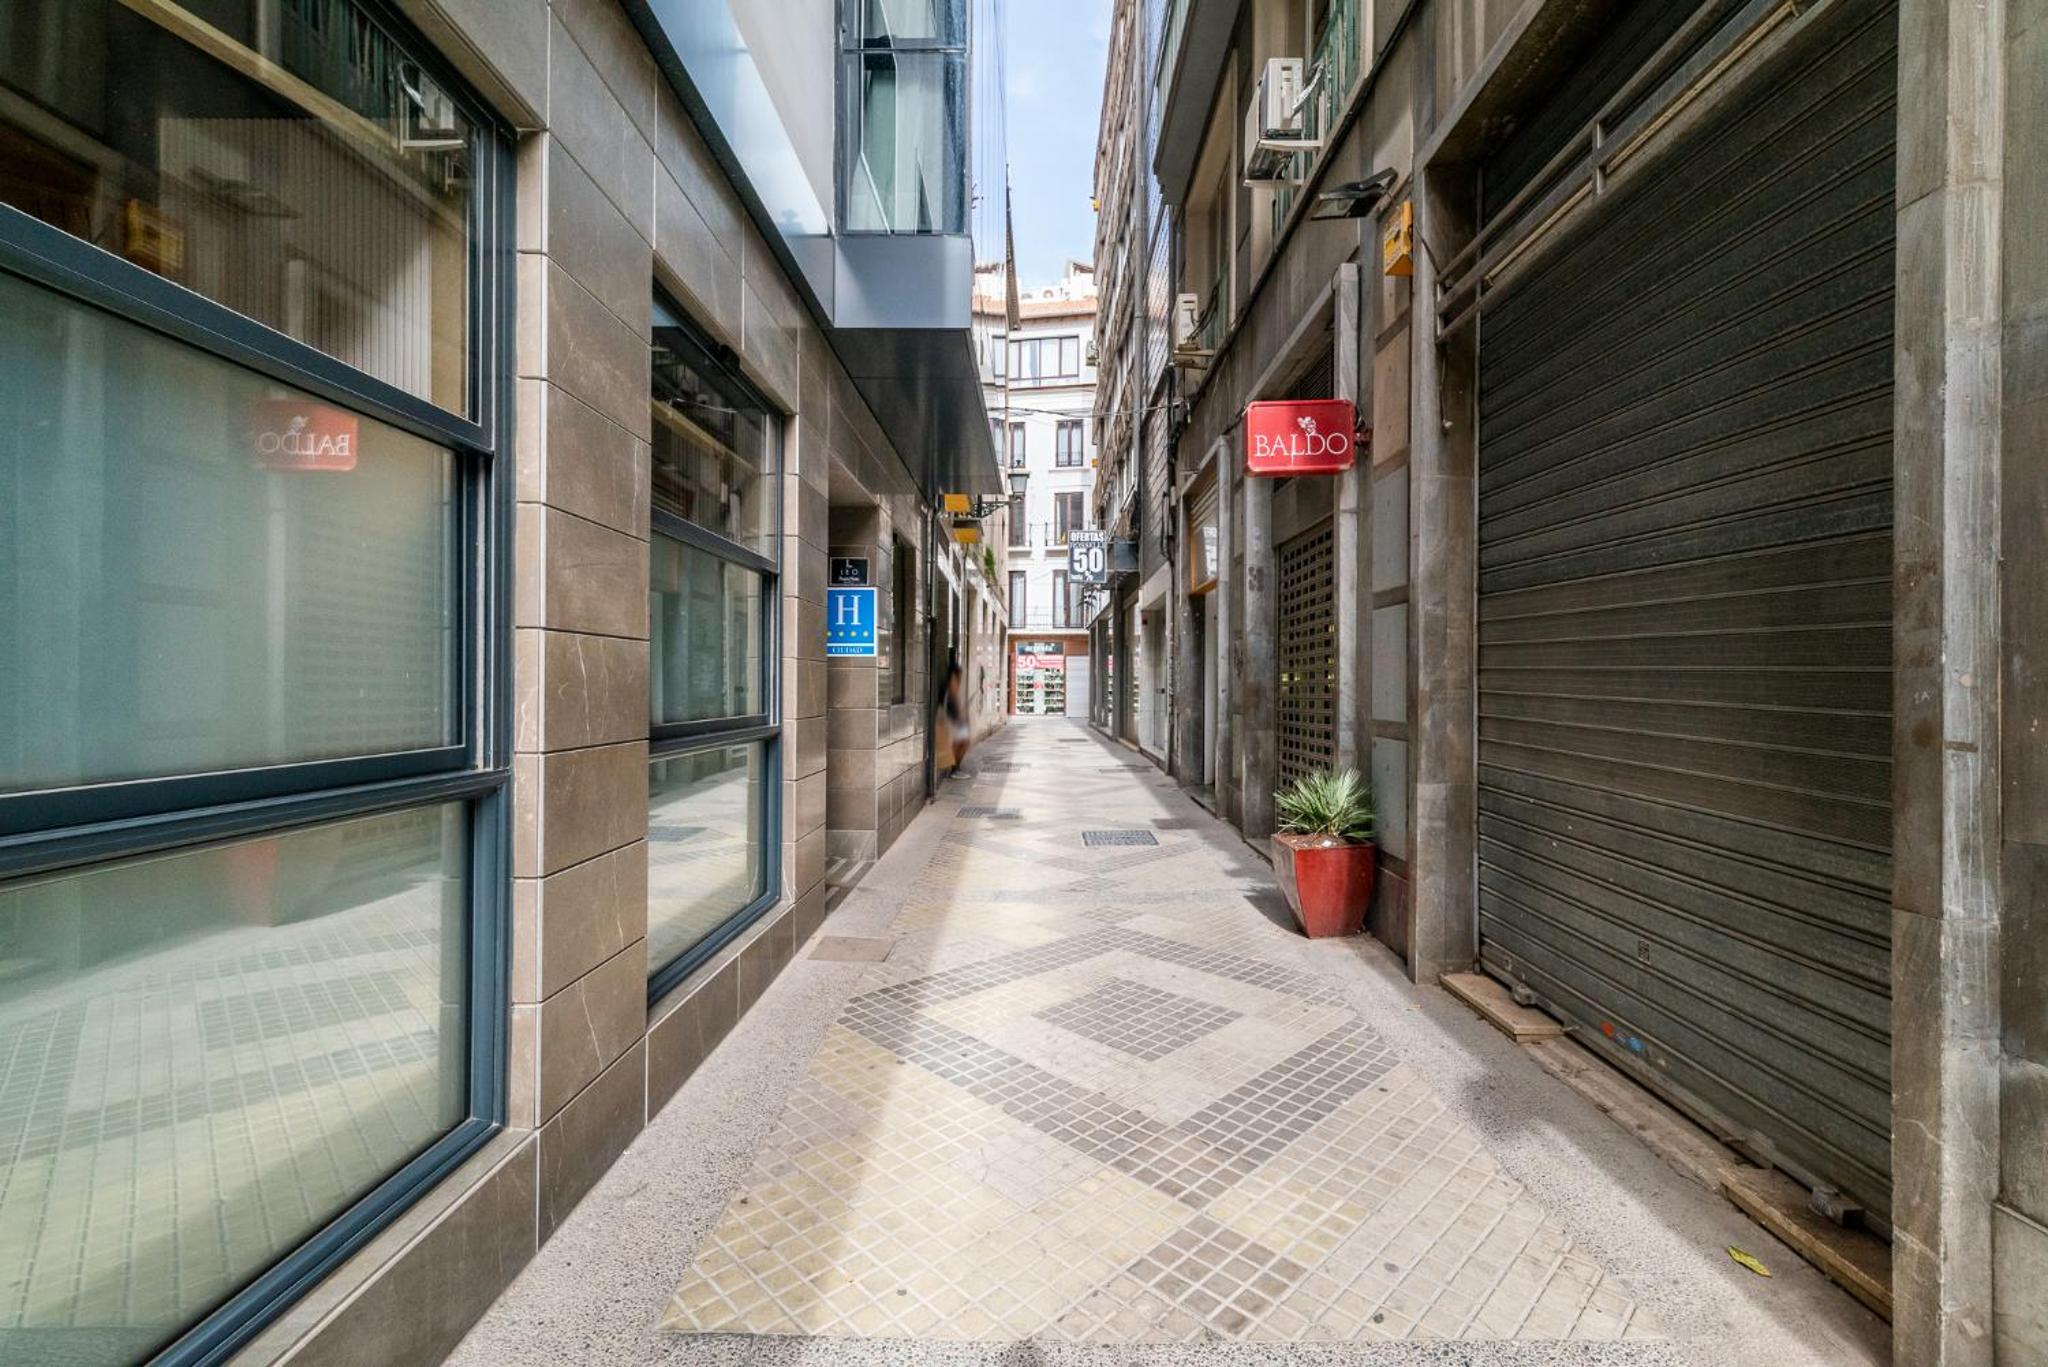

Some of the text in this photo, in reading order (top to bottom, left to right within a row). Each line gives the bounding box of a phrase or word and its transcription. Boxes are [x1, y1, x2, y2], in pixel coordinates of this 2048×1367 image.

[1254, 432, 1349, 460] BALDO
[1073, 548, 1104, 573] 50
[835, 594, 863, 626] H
